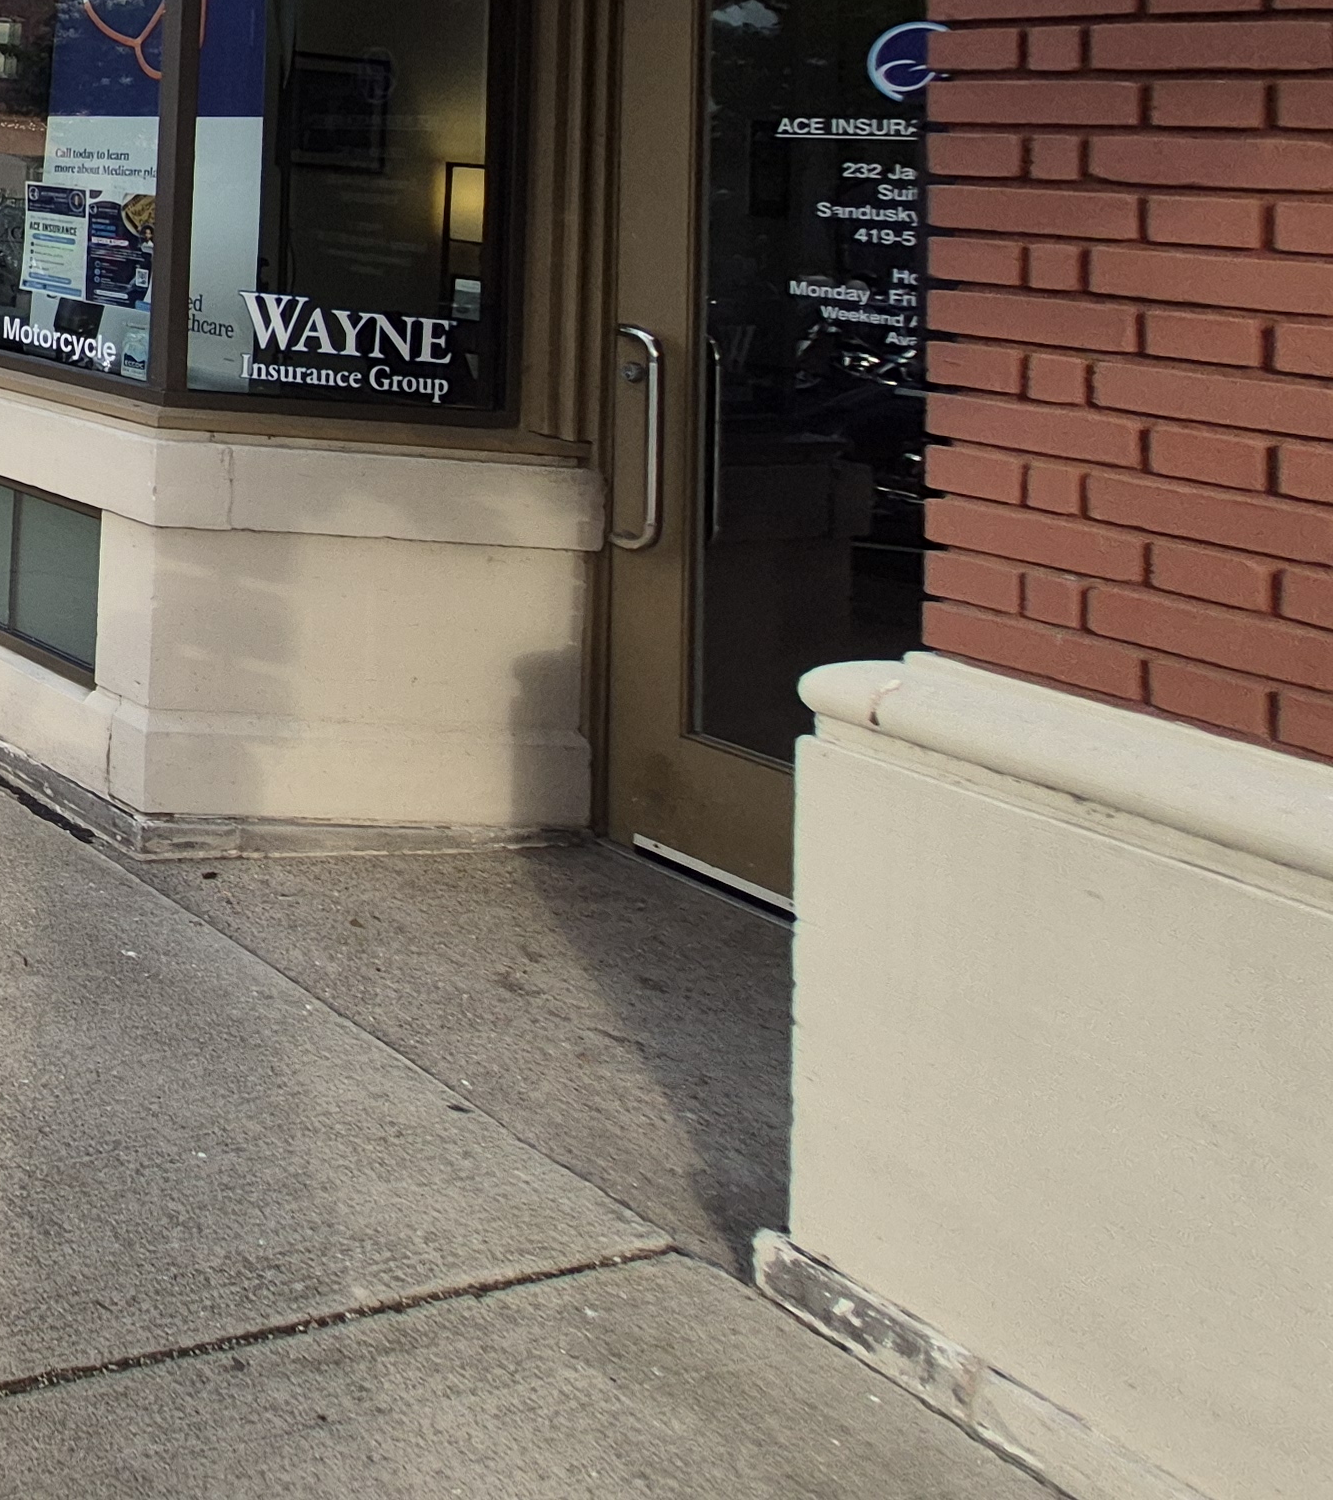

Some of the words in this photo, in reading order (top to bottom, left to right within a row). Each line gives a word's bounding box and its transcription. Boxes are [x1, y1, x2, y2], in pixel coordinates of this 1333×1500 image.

[777, 117, 825, 134] ACE
[55, 148, 72, 159] Call
[73, 150, 95, 162] today
[97, 150, 105, 160] to
[107, 149, 130, 161] learn
[54, 164, 76, 175] more
[77, 164, 100, 176] about
[102, 167, 143, 178] Medicare
[842, 163, 883, 179] 232
[30, 221, 41, 232] ACE
[42, 223, 78, 237] INSURANCE
[789, 281, 871, 305] Monday
[820, 304, 904, 328] Weekend
[239, 290, 457, 364] WAYNE
[3, 316, 117, 361] Motorcycle
[240, 354, 362, 388] Insurance
[369, 365, 449, 404] Group
